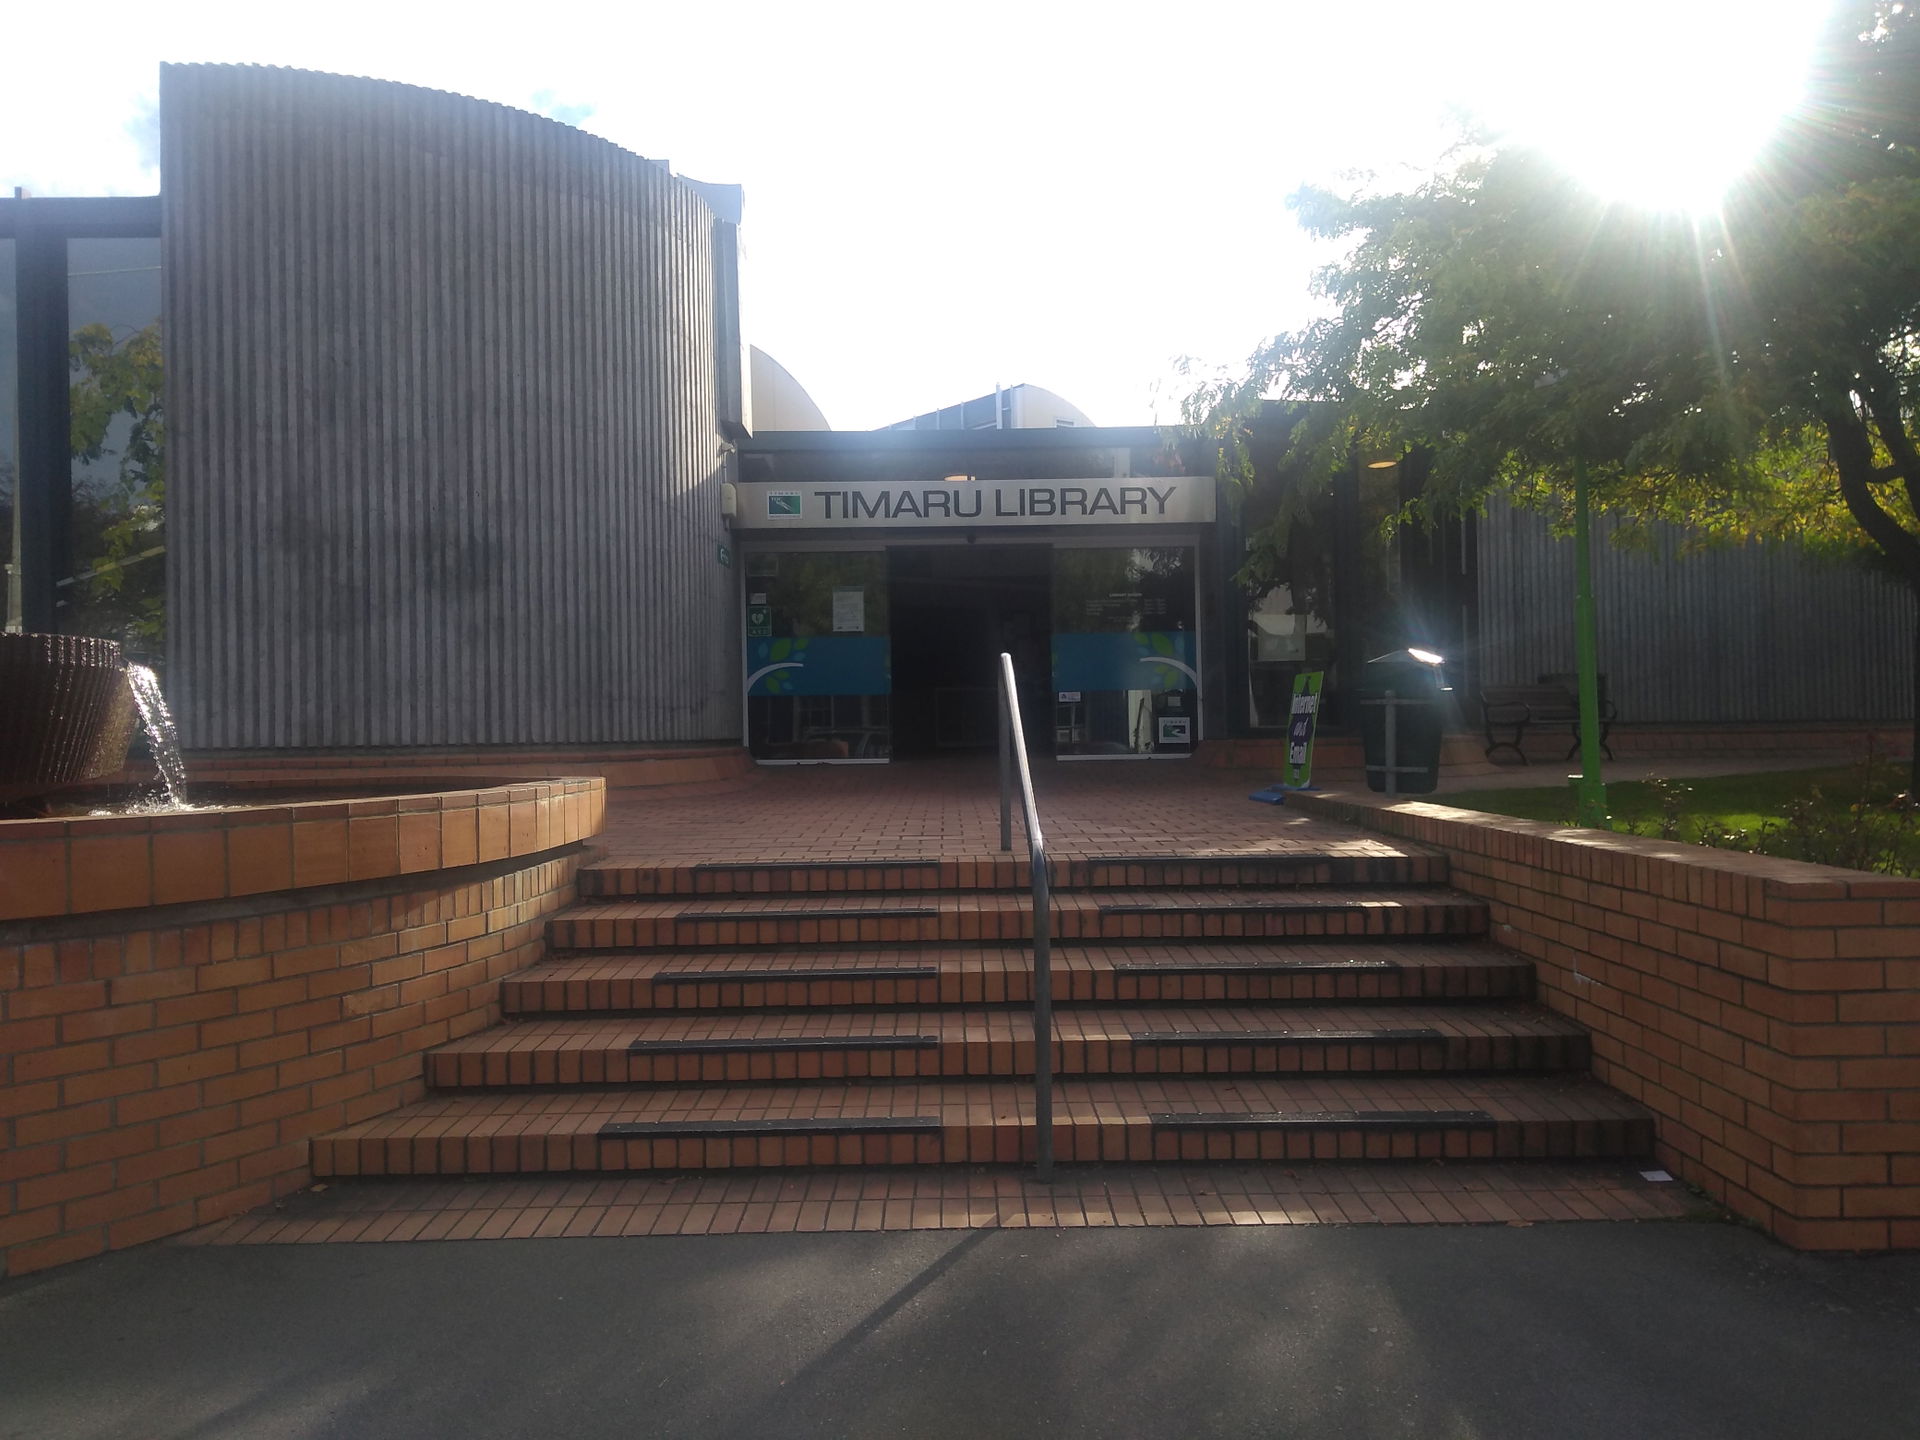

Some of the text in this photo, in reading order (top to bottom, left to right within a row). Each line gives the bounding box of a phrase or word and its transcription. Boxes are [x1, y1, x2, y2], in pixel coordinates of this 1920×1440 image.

[814, 486, 1177, 520] TIMARU LIBRARY
[1290, 692, 1318, 714] Internet
[1289, 742, 1307, 764] Email
